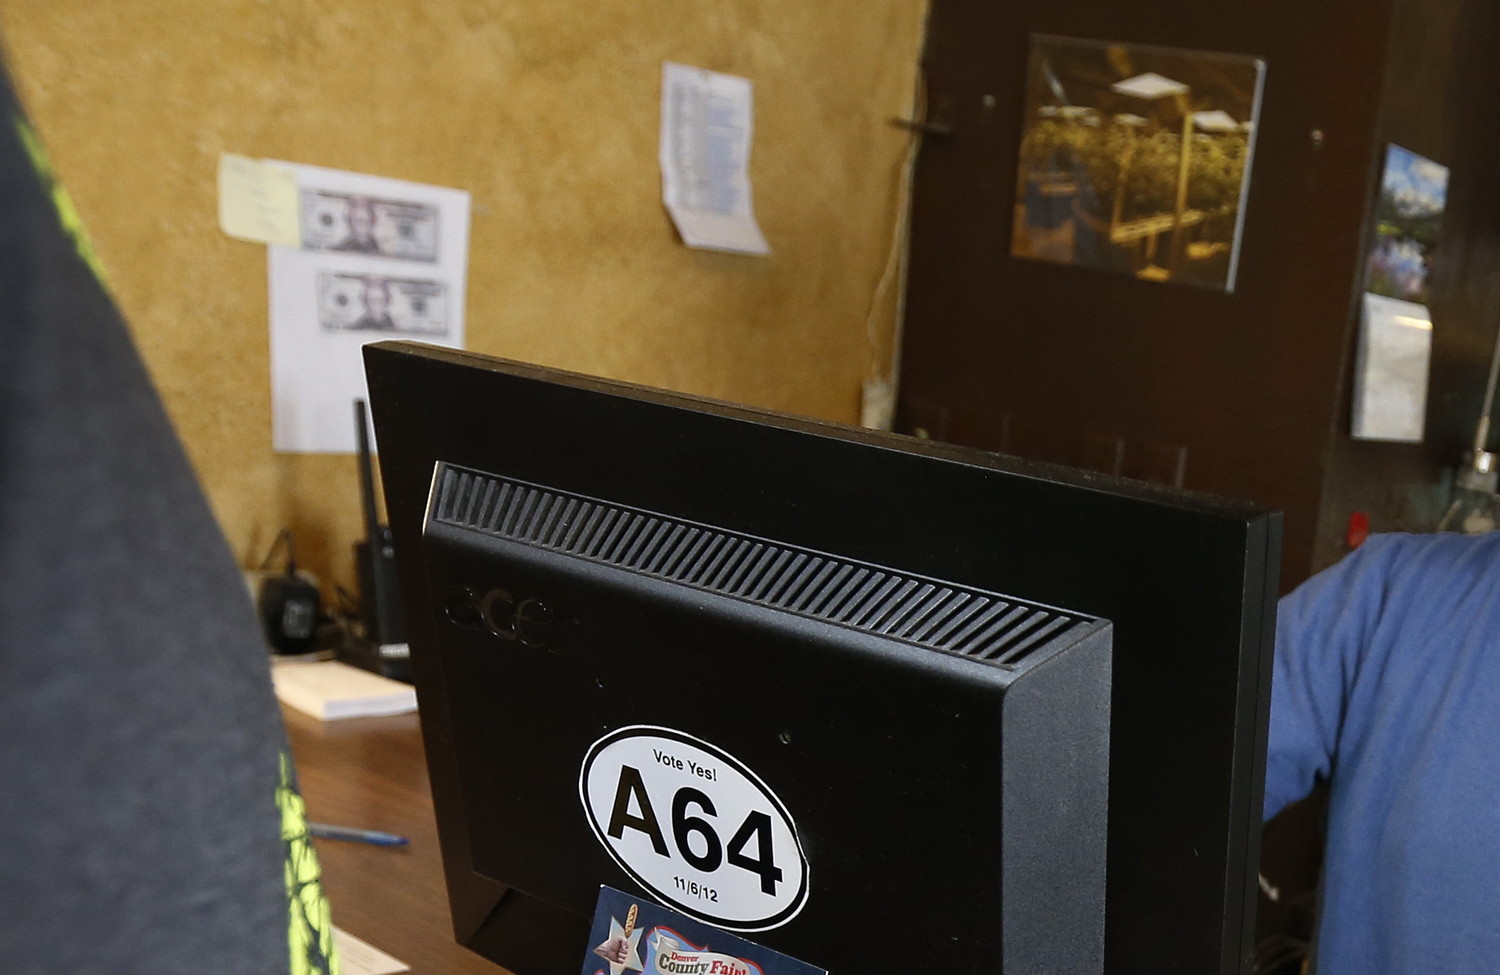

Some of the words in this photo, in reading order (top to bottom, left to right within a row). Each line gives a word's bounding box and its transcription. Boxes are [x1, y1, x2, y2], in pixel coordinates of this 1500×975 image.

[653, 748, 683, 771] Vote
[688, 759, 717, 782] Yes!
[608, 765, 782, 897] A64
[672, 874, 719, 903] 11/6/12
[670, 951, 700, 963] Denver
